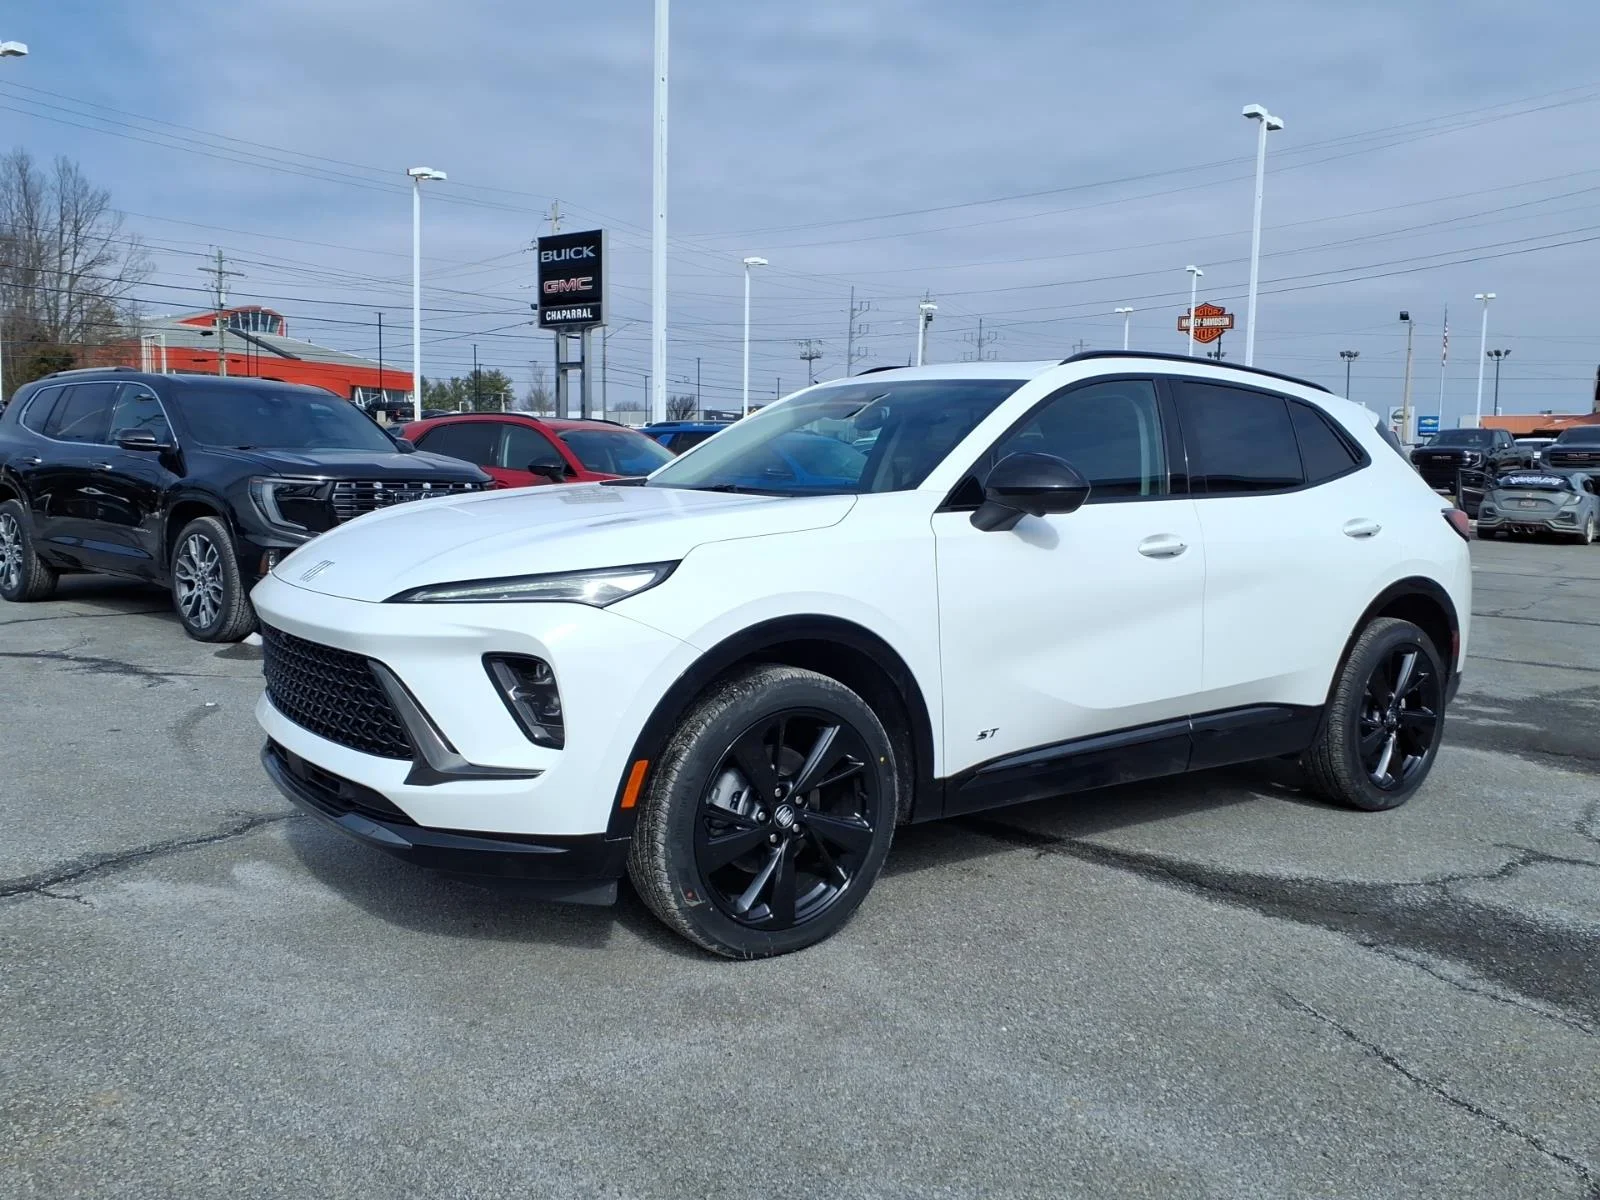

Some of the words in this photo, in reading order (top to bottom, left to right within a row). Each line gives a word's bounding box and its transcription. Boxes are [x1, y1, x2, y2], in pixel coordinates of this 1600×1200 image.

[540, 245, 596, 262] BUICK
[543, 276, 593, 294] GMC
[545, 308, 593, 321] CHAPARRAL
[1181, 317, 1230, 327] HAEY-DAVIDSON
[976, 727, 1000, 741] ST
